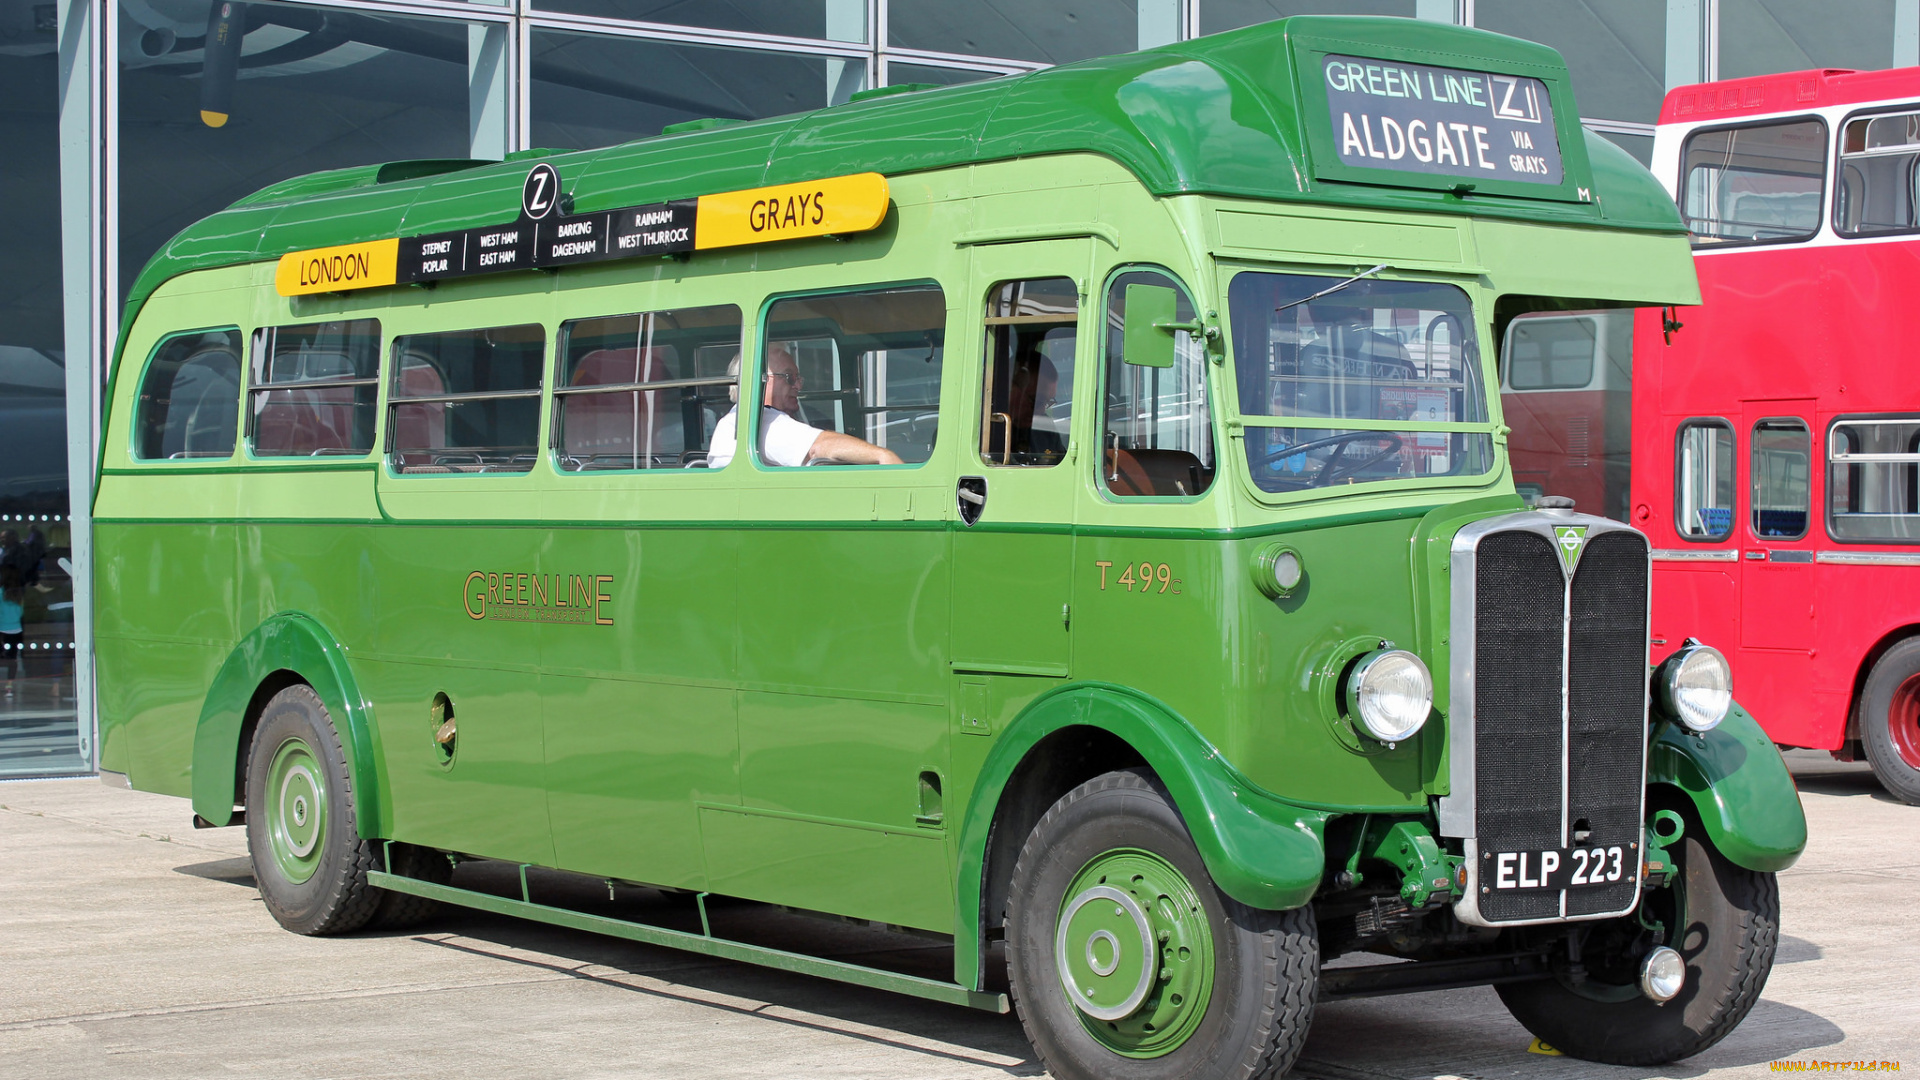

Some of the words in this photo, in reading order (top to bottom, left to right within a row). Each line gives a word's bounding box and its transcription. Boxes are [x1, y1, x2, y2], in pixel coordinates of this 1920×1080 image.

[1325, 61, 1422, 100] GREEN
[1428, 71, 1487, 107] LINE
[1343, 112, 1495, 170] ALDGATE
[1510, 131, 1534, 150] VIA
[1509, 154, 1547, 175] GRAYS
[530, 172, 549, 211] Z
[1577, 187, 1591, 202] M
[635, 210, 673, 227] RAINHAM
[749, 191, 824, 232] GRAYS
[480, 233, 500, 247] WEST
[501, 231, 518, 245] HAM
[558, 221, 592, 237] BARKING
[618, 234, 641, 249] WEST
[642, 228, 689, 246] THURROCK
[422, 240, 452, 256] STEPNEY
[480, 252, 498, 266] EAST
[498, 250, 516, 263] HAM
[552, 240, 596, 258] DAGENHAM
[300, 252, 370, 286] LONDON
[422, 259, 448, 273] POPLAR
[1095, 560, 1113, 591] T
[463, 570, 548, 620] GREEN
[555, 574, 614, 626] LINE
[493, 607, 530, 620] LONDON
[535, 609, 586, 622] TRANSPORT
[1497, 851, 1560, 888] ELP
[1571, 846, 1623, 885] 223
